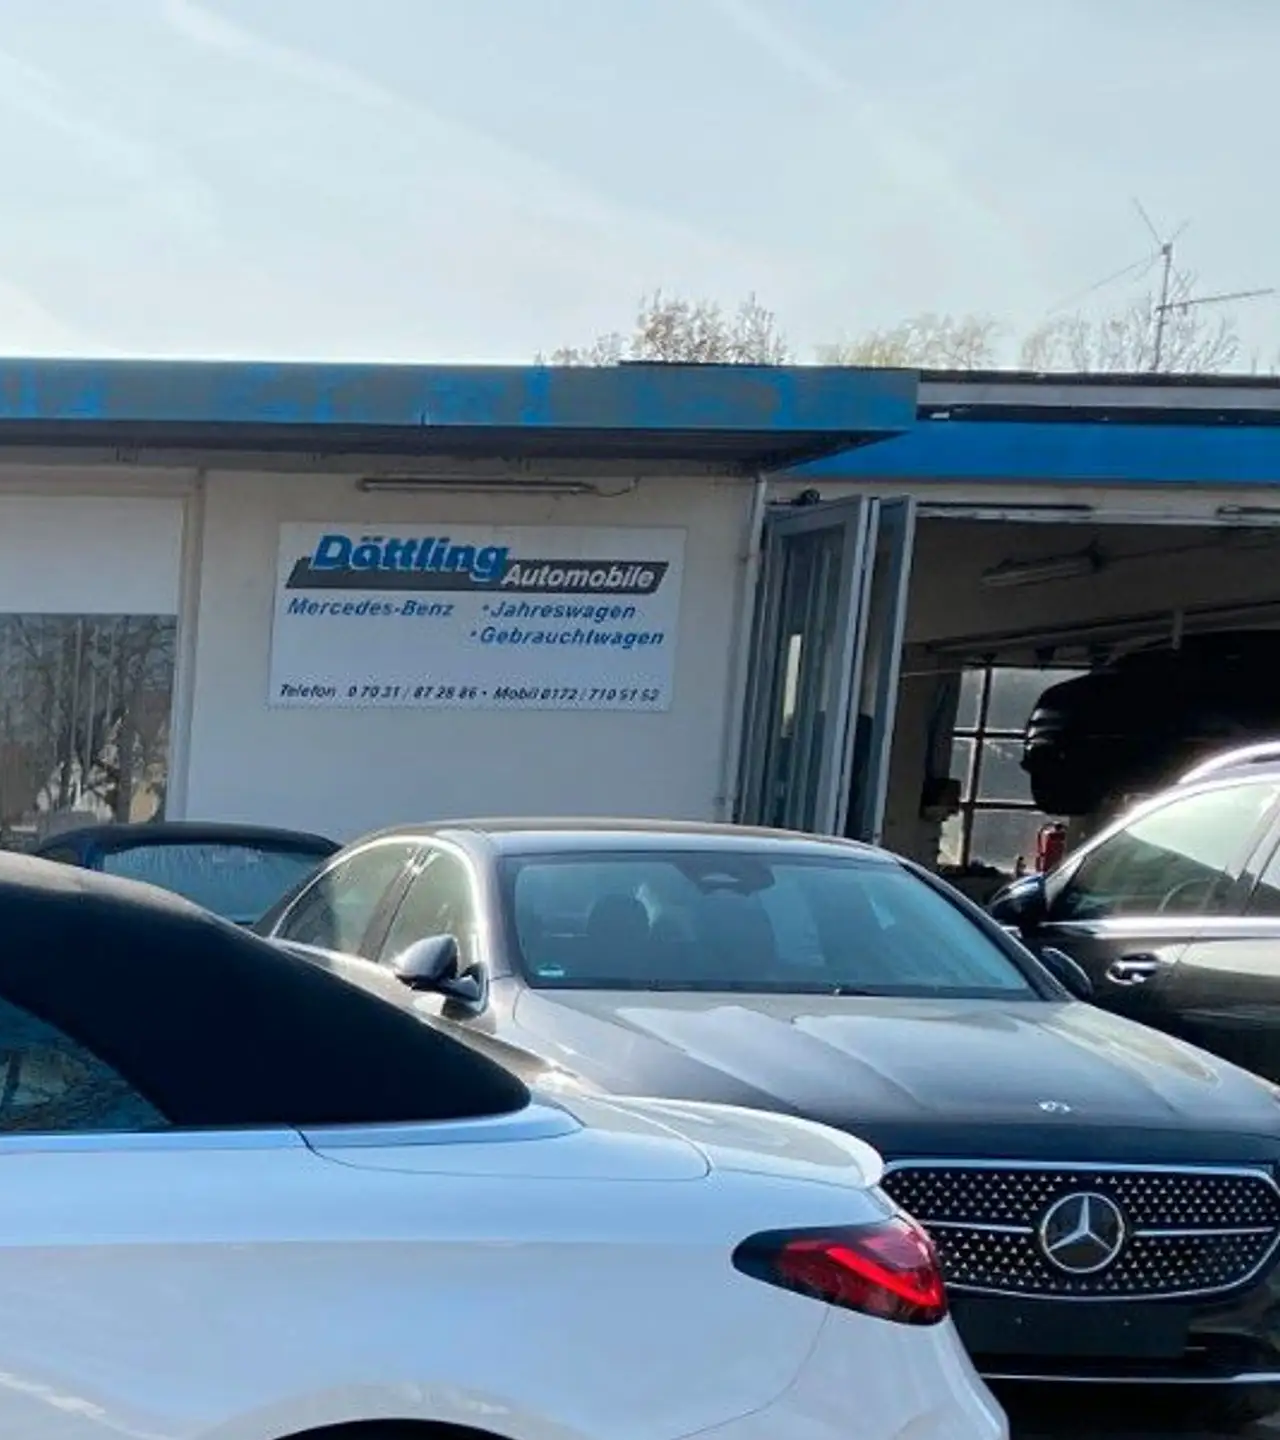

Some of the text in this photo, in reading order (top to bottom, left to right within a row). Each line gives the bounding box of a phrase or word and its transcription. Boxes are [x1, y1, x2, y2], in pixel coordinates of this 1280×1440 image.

[310, 533, 509, 582] Döttling
[500, 563, 656, 589] Automobile
[287, 597, 637, 624] Mercedes-Benz Jahreswagen
[479, 626, 665, 649] Gebrauchtwagen
[280, 684, 336, 698] Telefon
